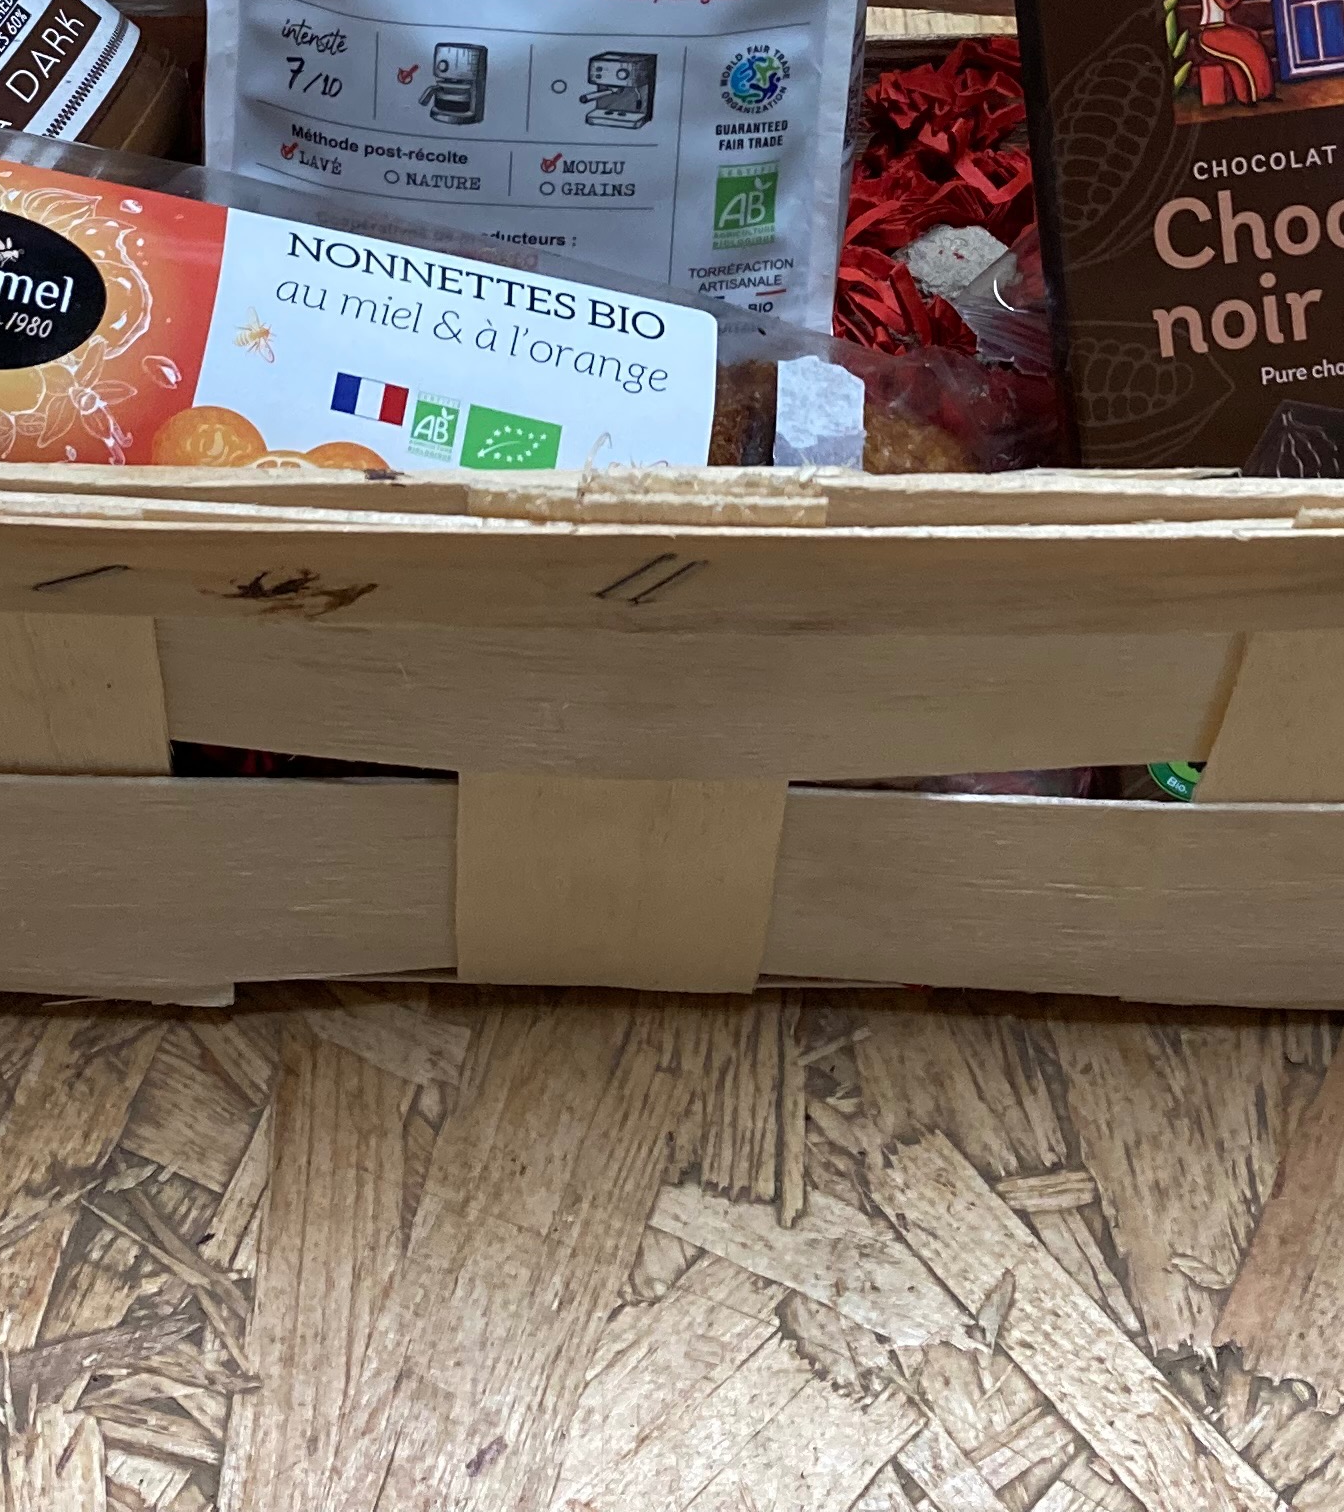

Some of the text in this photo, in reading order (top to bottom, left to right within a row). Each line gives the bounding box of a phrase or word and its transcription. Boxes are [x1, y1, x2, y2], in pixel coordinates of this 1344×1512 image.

[7, 8, 28, 34] 60%
[6, 8, 85, 104] DARK
[720, 45, 790, 86] WORLD FAIR TRADE
[721, 86, 787, 114] ORGANIZATION
[716, 120, 788, 135] GUARANTEED
[291, 124, 468, 166] Méthode post-récolte
[719, 135, 783, 150] FAIR TRADE
[299, 149, 343, 176] LAVÉ
[562, 160, 626, 175] MOULU
[1193, 145, 1337, 180] CHOCOLAT
[405, 173, 481, 191] NATURE
[561, 182, 636, 197] GRAINS
[718, 191, 766, 228] AB
[688, 258, 794, 279] TORRÉFACTION
[287, 232, 576, 320] NONNETTES
[588, 299, 666, 340] BIO
[698, 274, 783, 293] ARTISANALE
[5, 311, 53, 338] 1980
[1152, 271, 1323, 358] noir
[276, 281, 669, 394] au miel & à l'orange
[1261, 366, 1307, 386] Pure
[413, 414, 449, 444] AB
